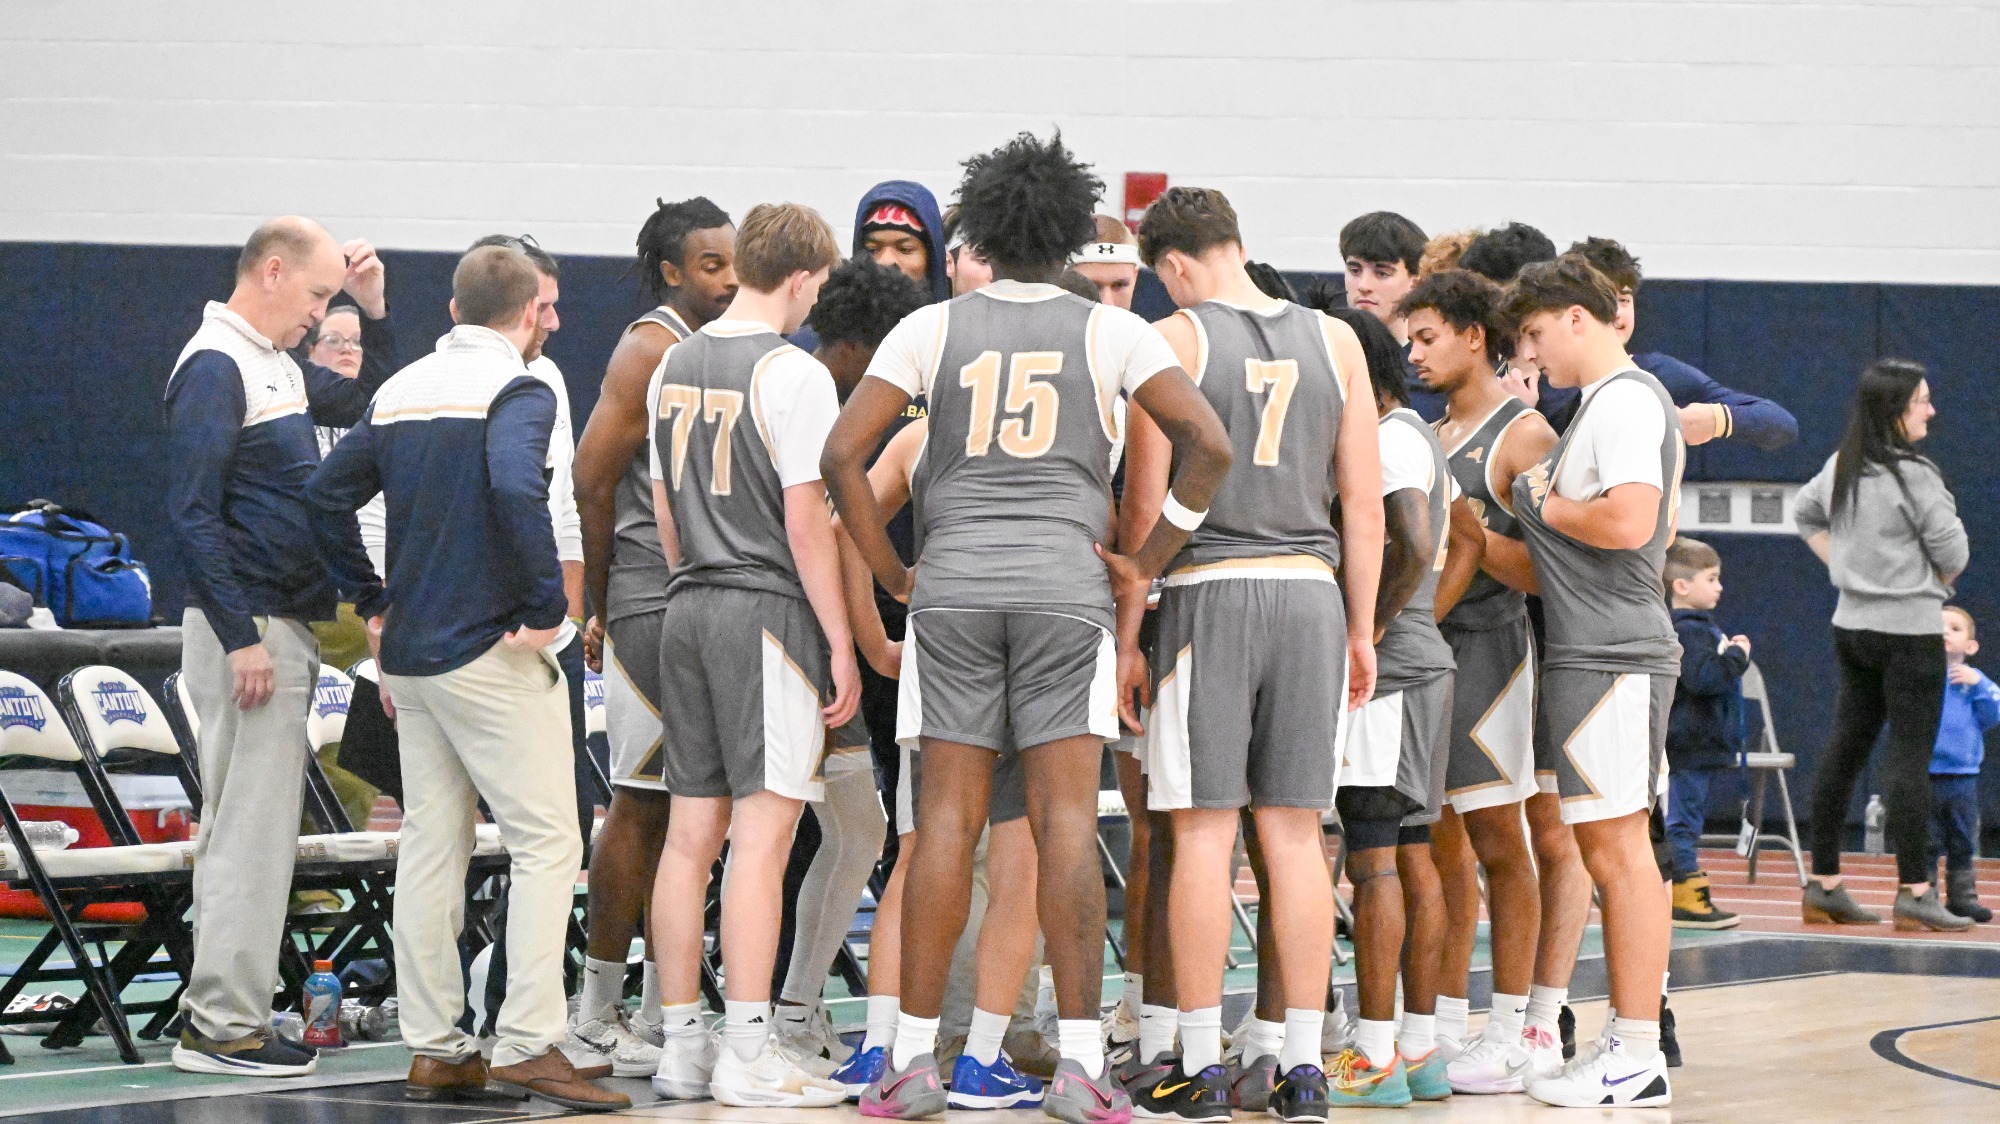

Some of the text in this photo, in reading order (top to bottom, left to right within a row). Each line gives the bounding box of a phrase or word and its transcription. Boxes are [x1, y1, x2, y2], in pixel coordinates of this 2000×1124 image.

[658, 383, 744, 496] 77
[959, 350, 1064, 459] 15
[1244, 357, 1299, 467] 7
[0, 697, 46, 720] ANTON
[91, 692, 146, 716] CANTON
